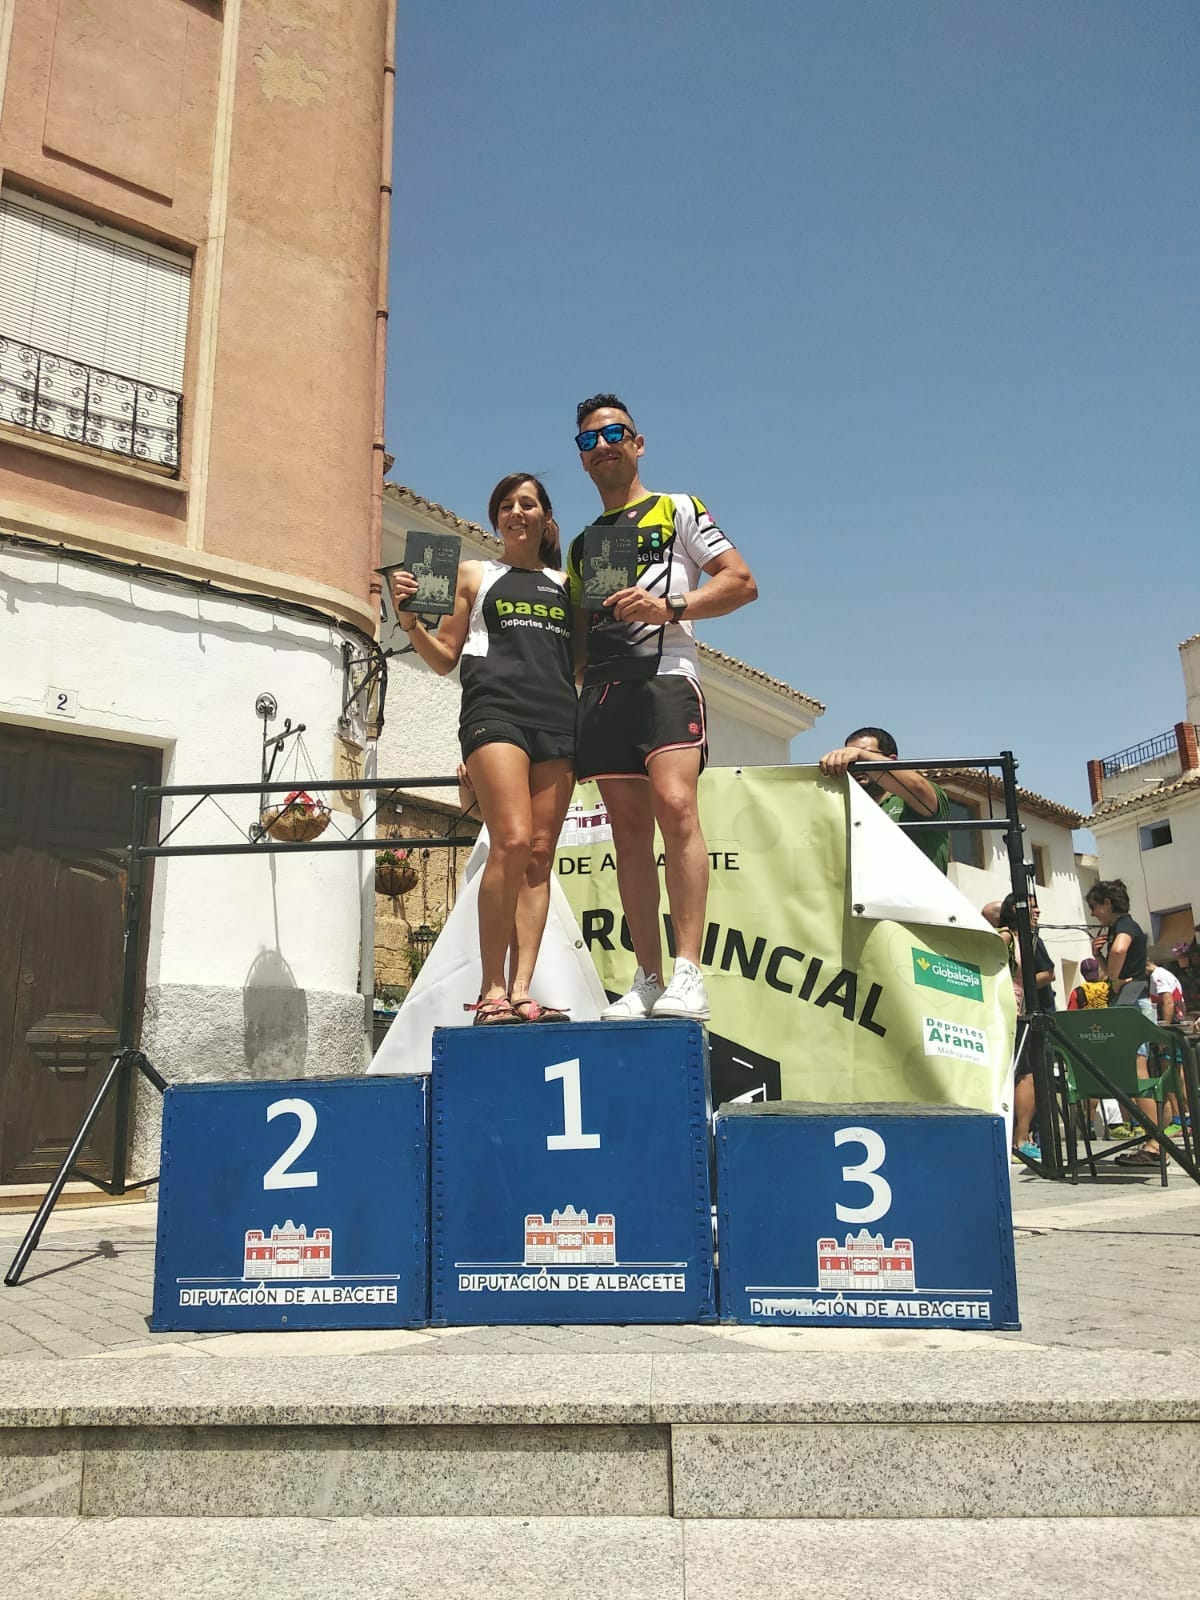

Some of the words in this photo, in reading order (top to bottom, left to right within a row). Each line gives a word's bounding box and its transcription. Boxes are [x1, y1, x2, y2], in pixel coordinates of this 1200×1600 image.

[495, 599, 565, 620] base
[500, 618, 543, 629] Deportes
[56, 693, 68, 711] 2
[558, 857, 592, 875] DE
[931, 964, 980, 987] Globalcaja
[926, 1018, 984, 1039] Deportes
[928, 1028, 985, 1054] Arana
[544, 1058, 600, 1151] 1
[263, 1098, 318, 1190] 2
[833, 1126, 893, 1224] 3
[460, 1268, 560, 1290] DIPUTACIÓN
[568, 1276, 588, 1289] DE
[595, 1276, 684, 1290] ALBACETE
[181, 1284, 277, 1305] DIPUTACIÓN
[285, 1289, 305, 1303] DE
[311, 1288, 396, 1303] ALBACETE
[866, 1302, 889, 1317] DE
[896, 1302, 988, 1319] ALBACETE
